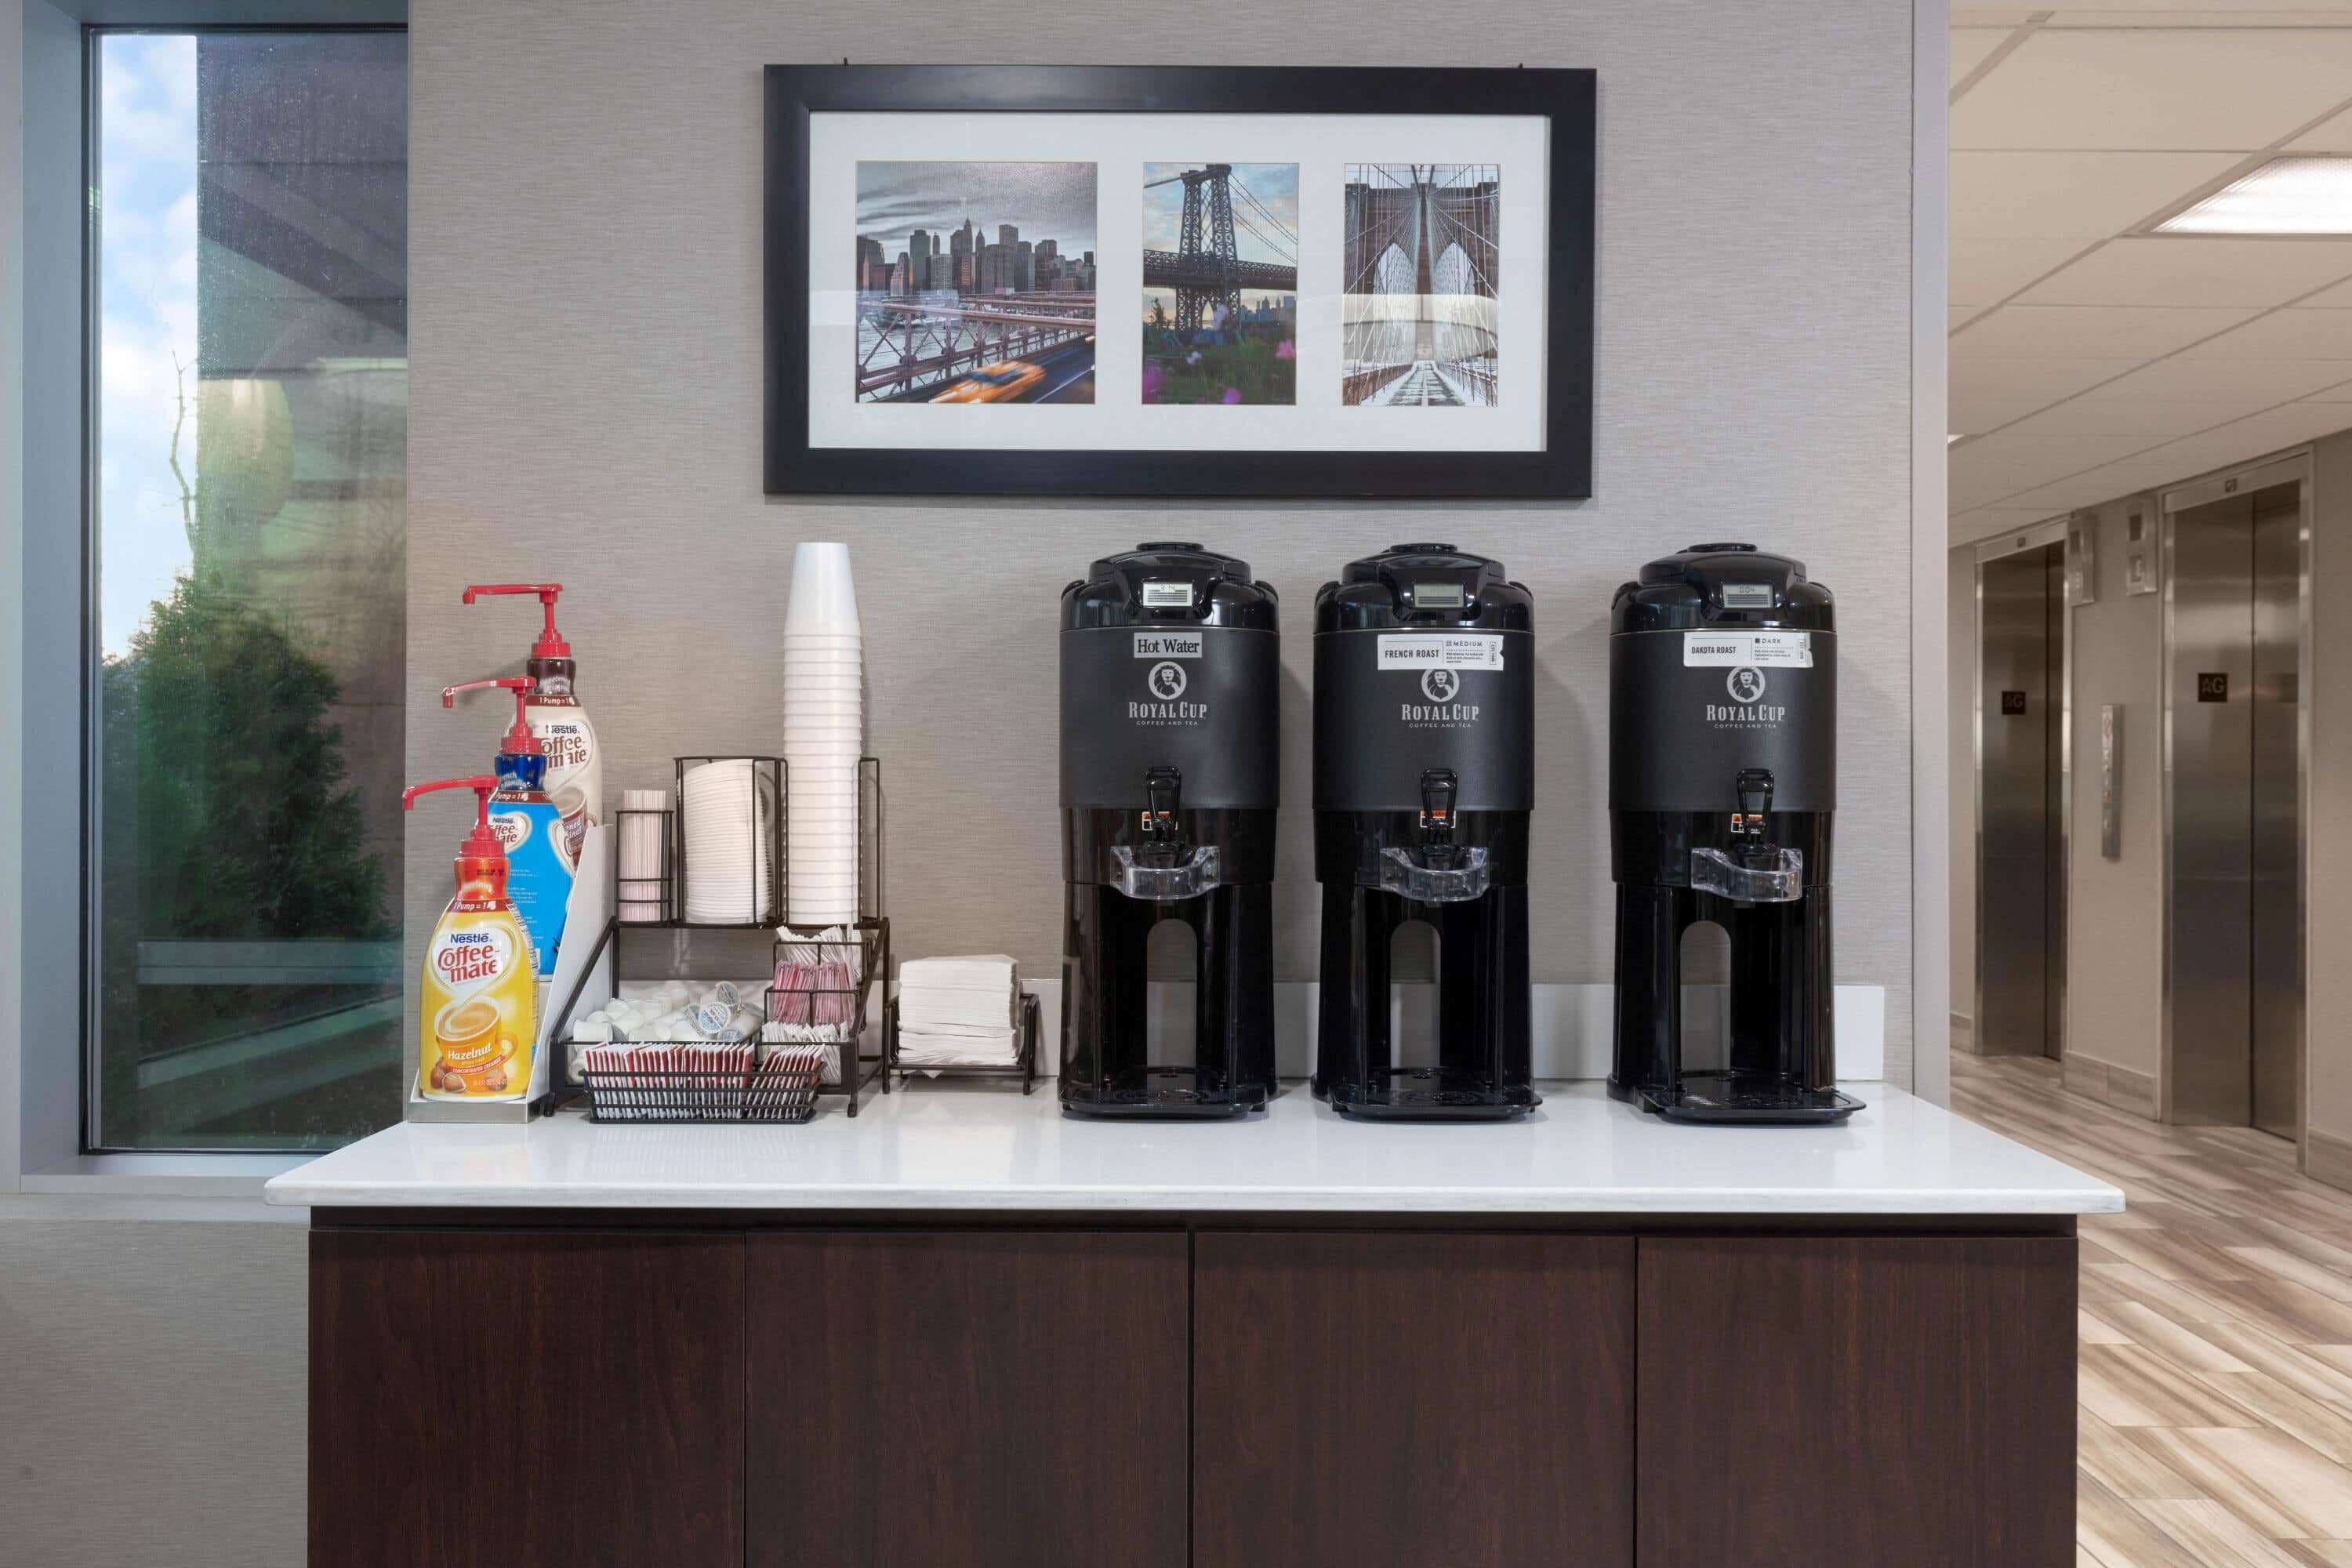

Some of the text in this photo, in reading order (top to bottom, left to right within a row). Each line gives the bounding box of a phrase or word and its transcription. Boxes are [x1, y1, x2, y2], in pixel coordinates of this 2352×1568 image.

[1137, 639, 1200, 653] Hot Water
[1385, 649, 1414, 659] FRENCH
[1416, 649, 1439, 658] ROAST
[1129, 702, 1207, 718] ROYAL CUP
[1401, 704, 1479, 720] ROYAL CUP
[1706, 704, 1785, 720] ROYAL CUP
[457, 902, 475, 911] Pump
[450, 960, 498, 983] mate
[448, 1042, 492, 1061] Hazelnut
